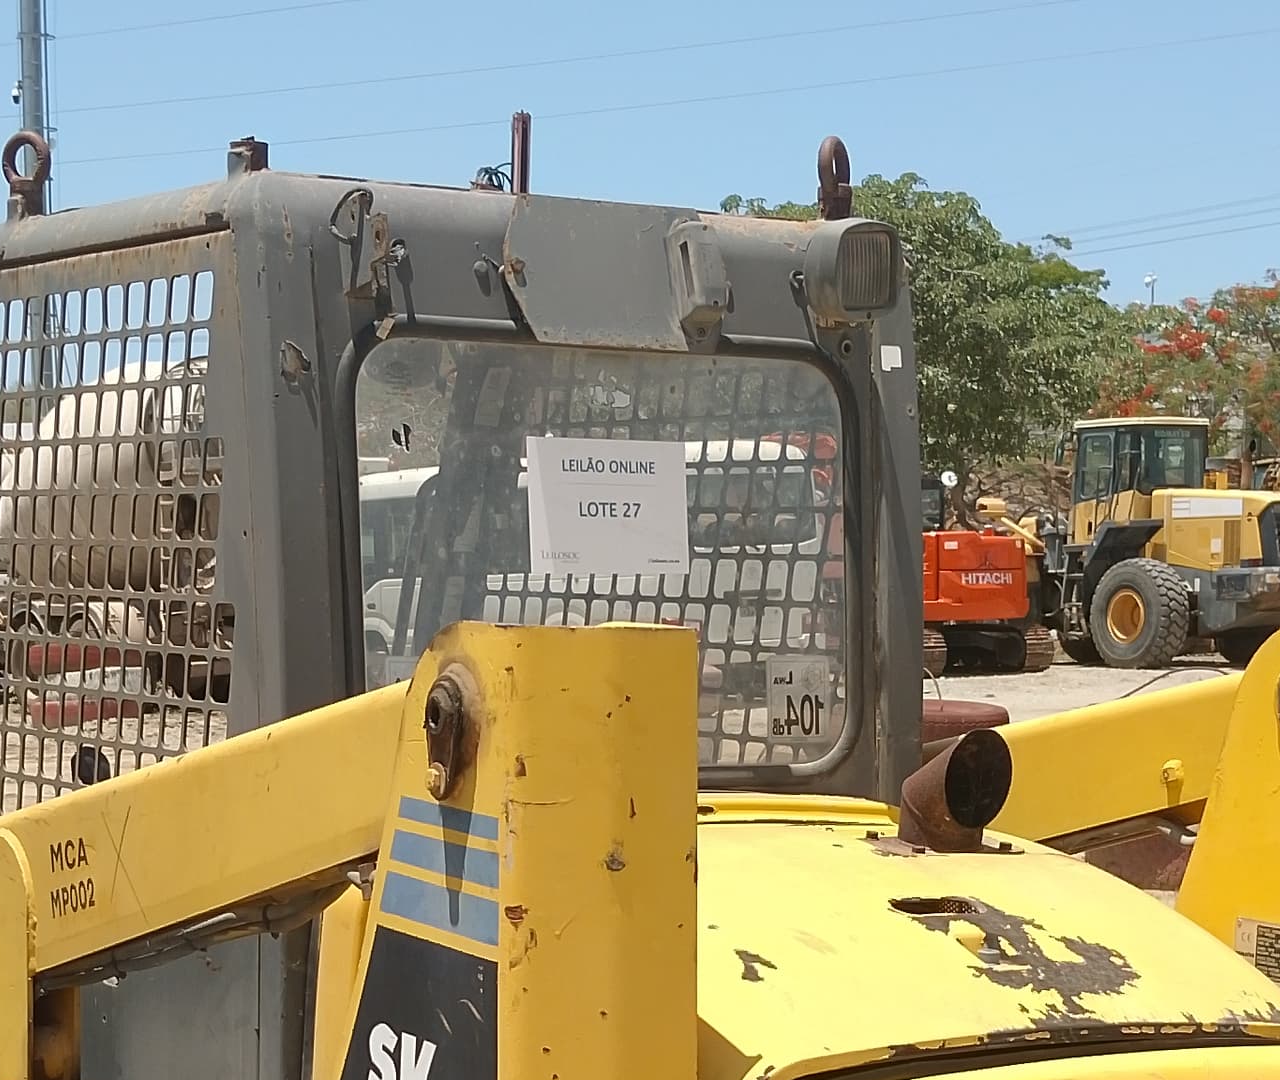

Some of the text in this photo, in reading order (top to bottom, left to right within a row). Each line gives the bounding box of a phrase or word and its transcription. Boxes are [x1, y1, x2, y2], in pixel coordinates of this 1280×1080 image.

[561, 457, 656, 475] LEILÃO ONLINE
[578, 501, 642, 518] LOTE 27
[961, 572, 1013, 585] HITACHI
[49, 837, 90, 874] MCA
[49, 877, 97, 919] MP002
